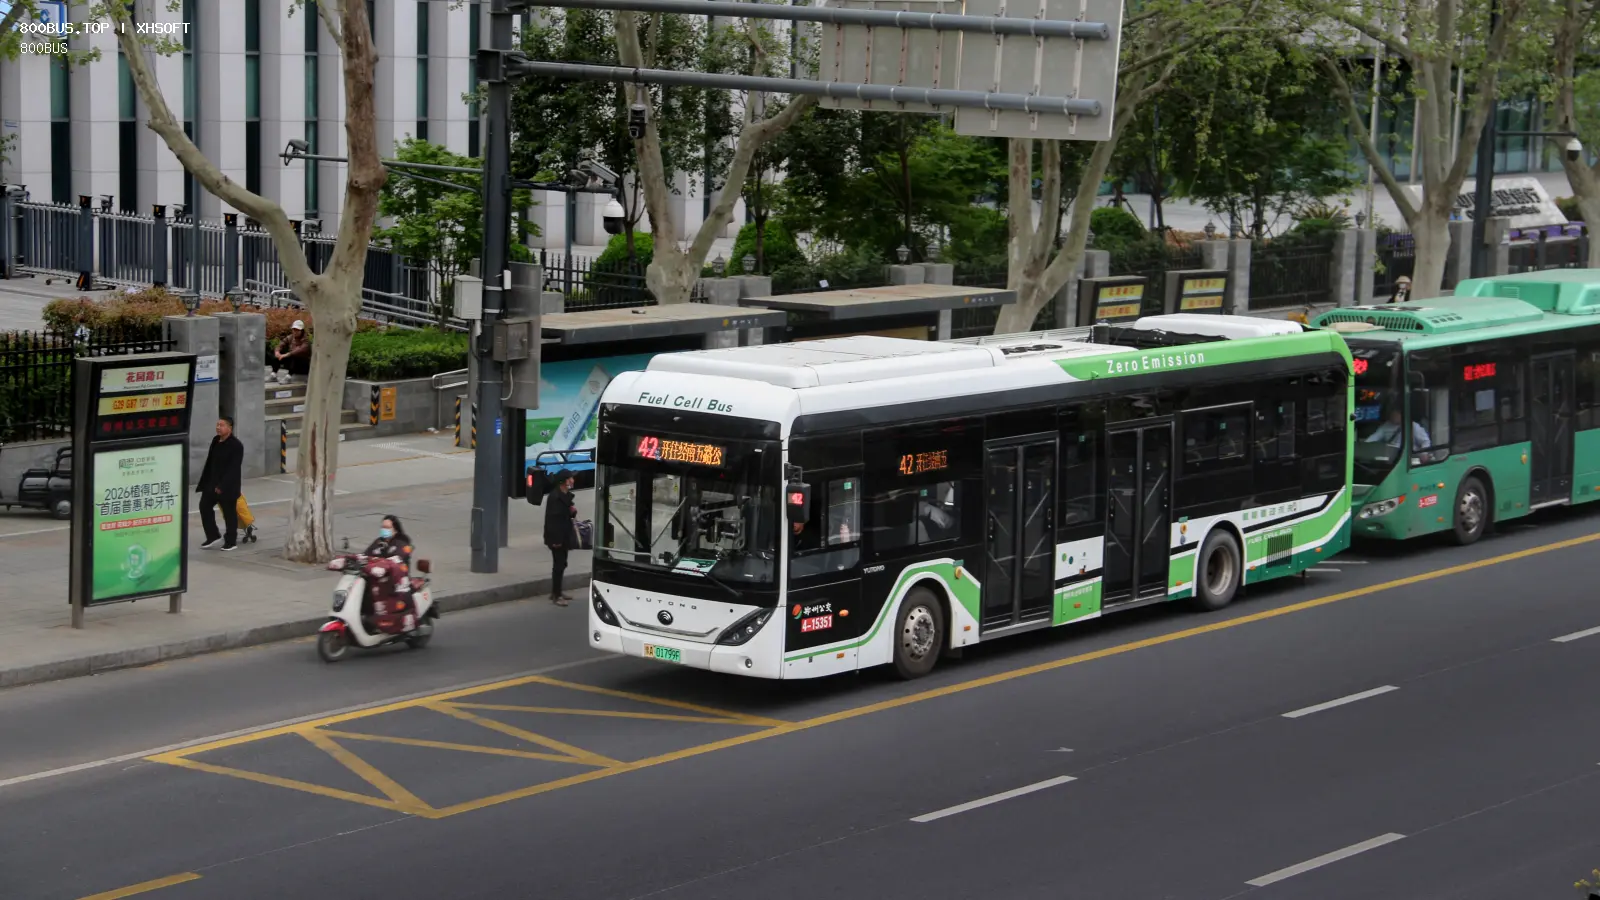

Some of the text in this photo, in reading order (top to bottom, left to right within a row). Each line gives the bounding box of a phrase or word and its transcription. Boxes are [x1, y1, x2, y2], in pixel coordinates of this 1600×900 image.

[1106, 351, 1205, 374] Zero Emission
[125, 370, 165, 383] 花园路口
[638, 391, 733, 412] Fuel Cell Bus
[638, 436, 659, 459] 42
[899, 454, 914, 475] 42
[104, 480, 171, 501] 2026植得口腔
[96, 494, 179, 516] 首届普惠种牙节
[635, 596, 698, 610] YUTONG
[803, 602, 833, 616] 郑州公交
[802, 615, 833, 632] 4-15351
